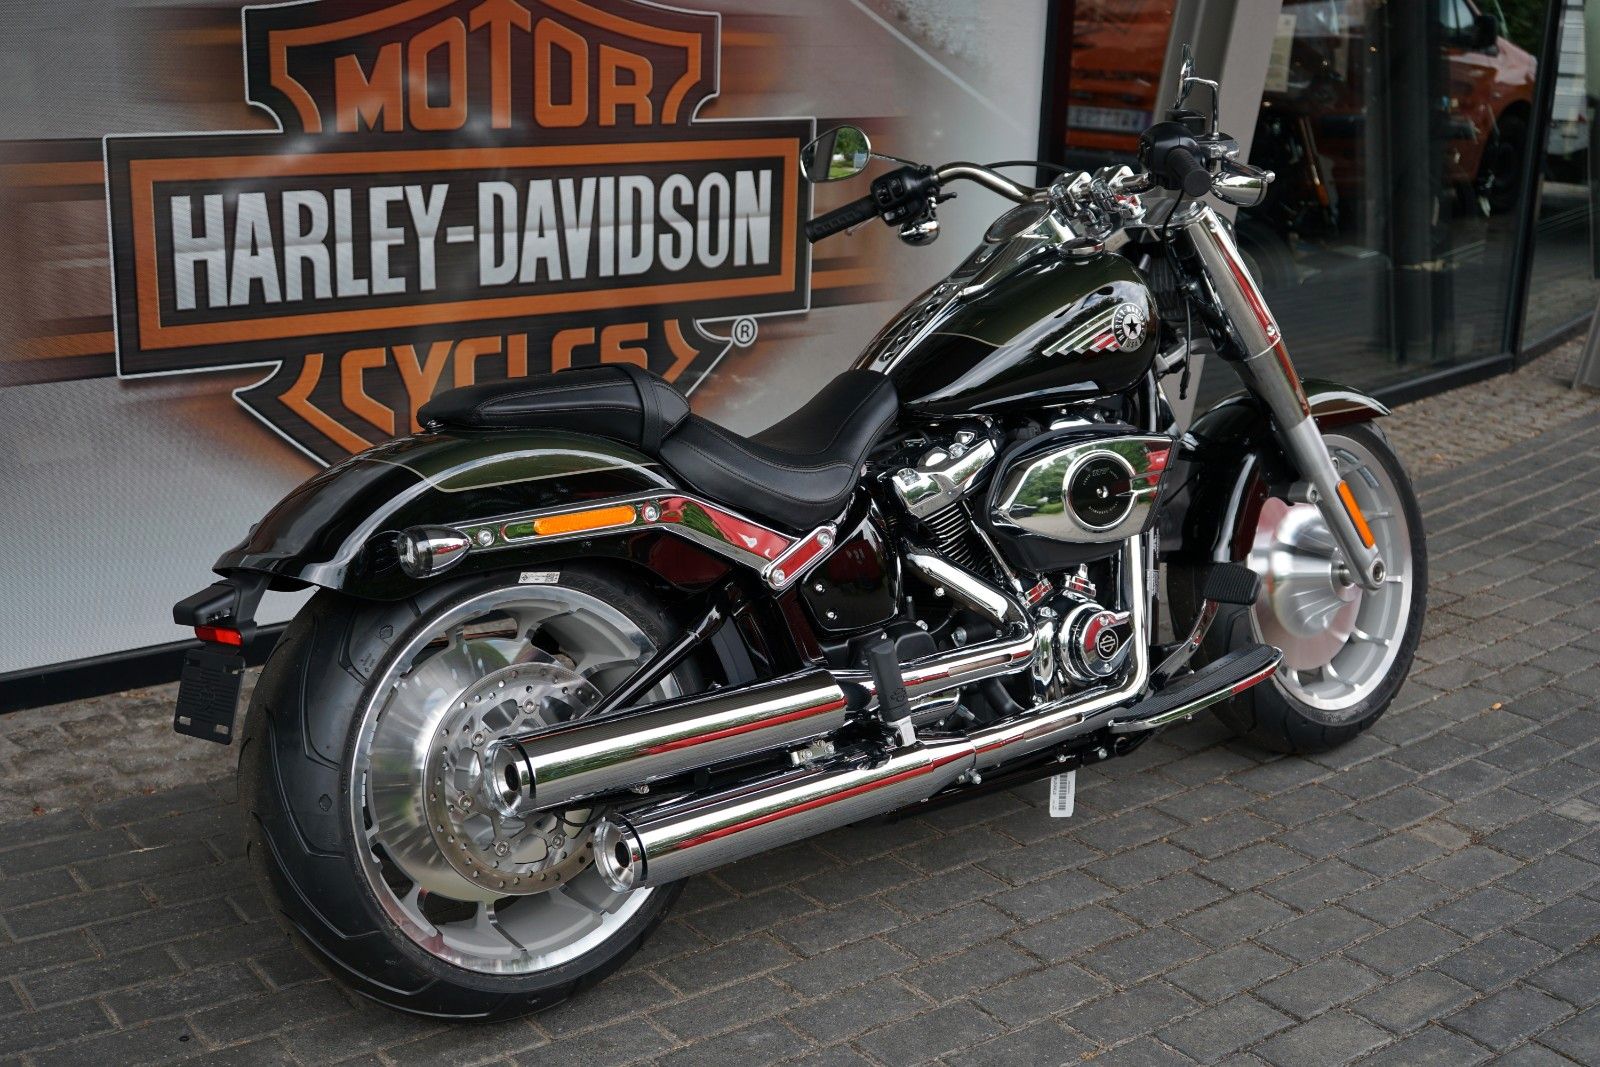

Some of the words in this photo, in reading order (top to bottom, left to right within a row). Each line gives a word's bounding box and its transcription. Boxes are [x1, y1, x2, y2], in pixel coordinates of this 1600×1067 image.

[335, 0, 653, 133] MOTOR
[170, 169, 773, 311] HARLEY-DAVIDSON
[1115, 305, 1146, 341] HARLEY-D
